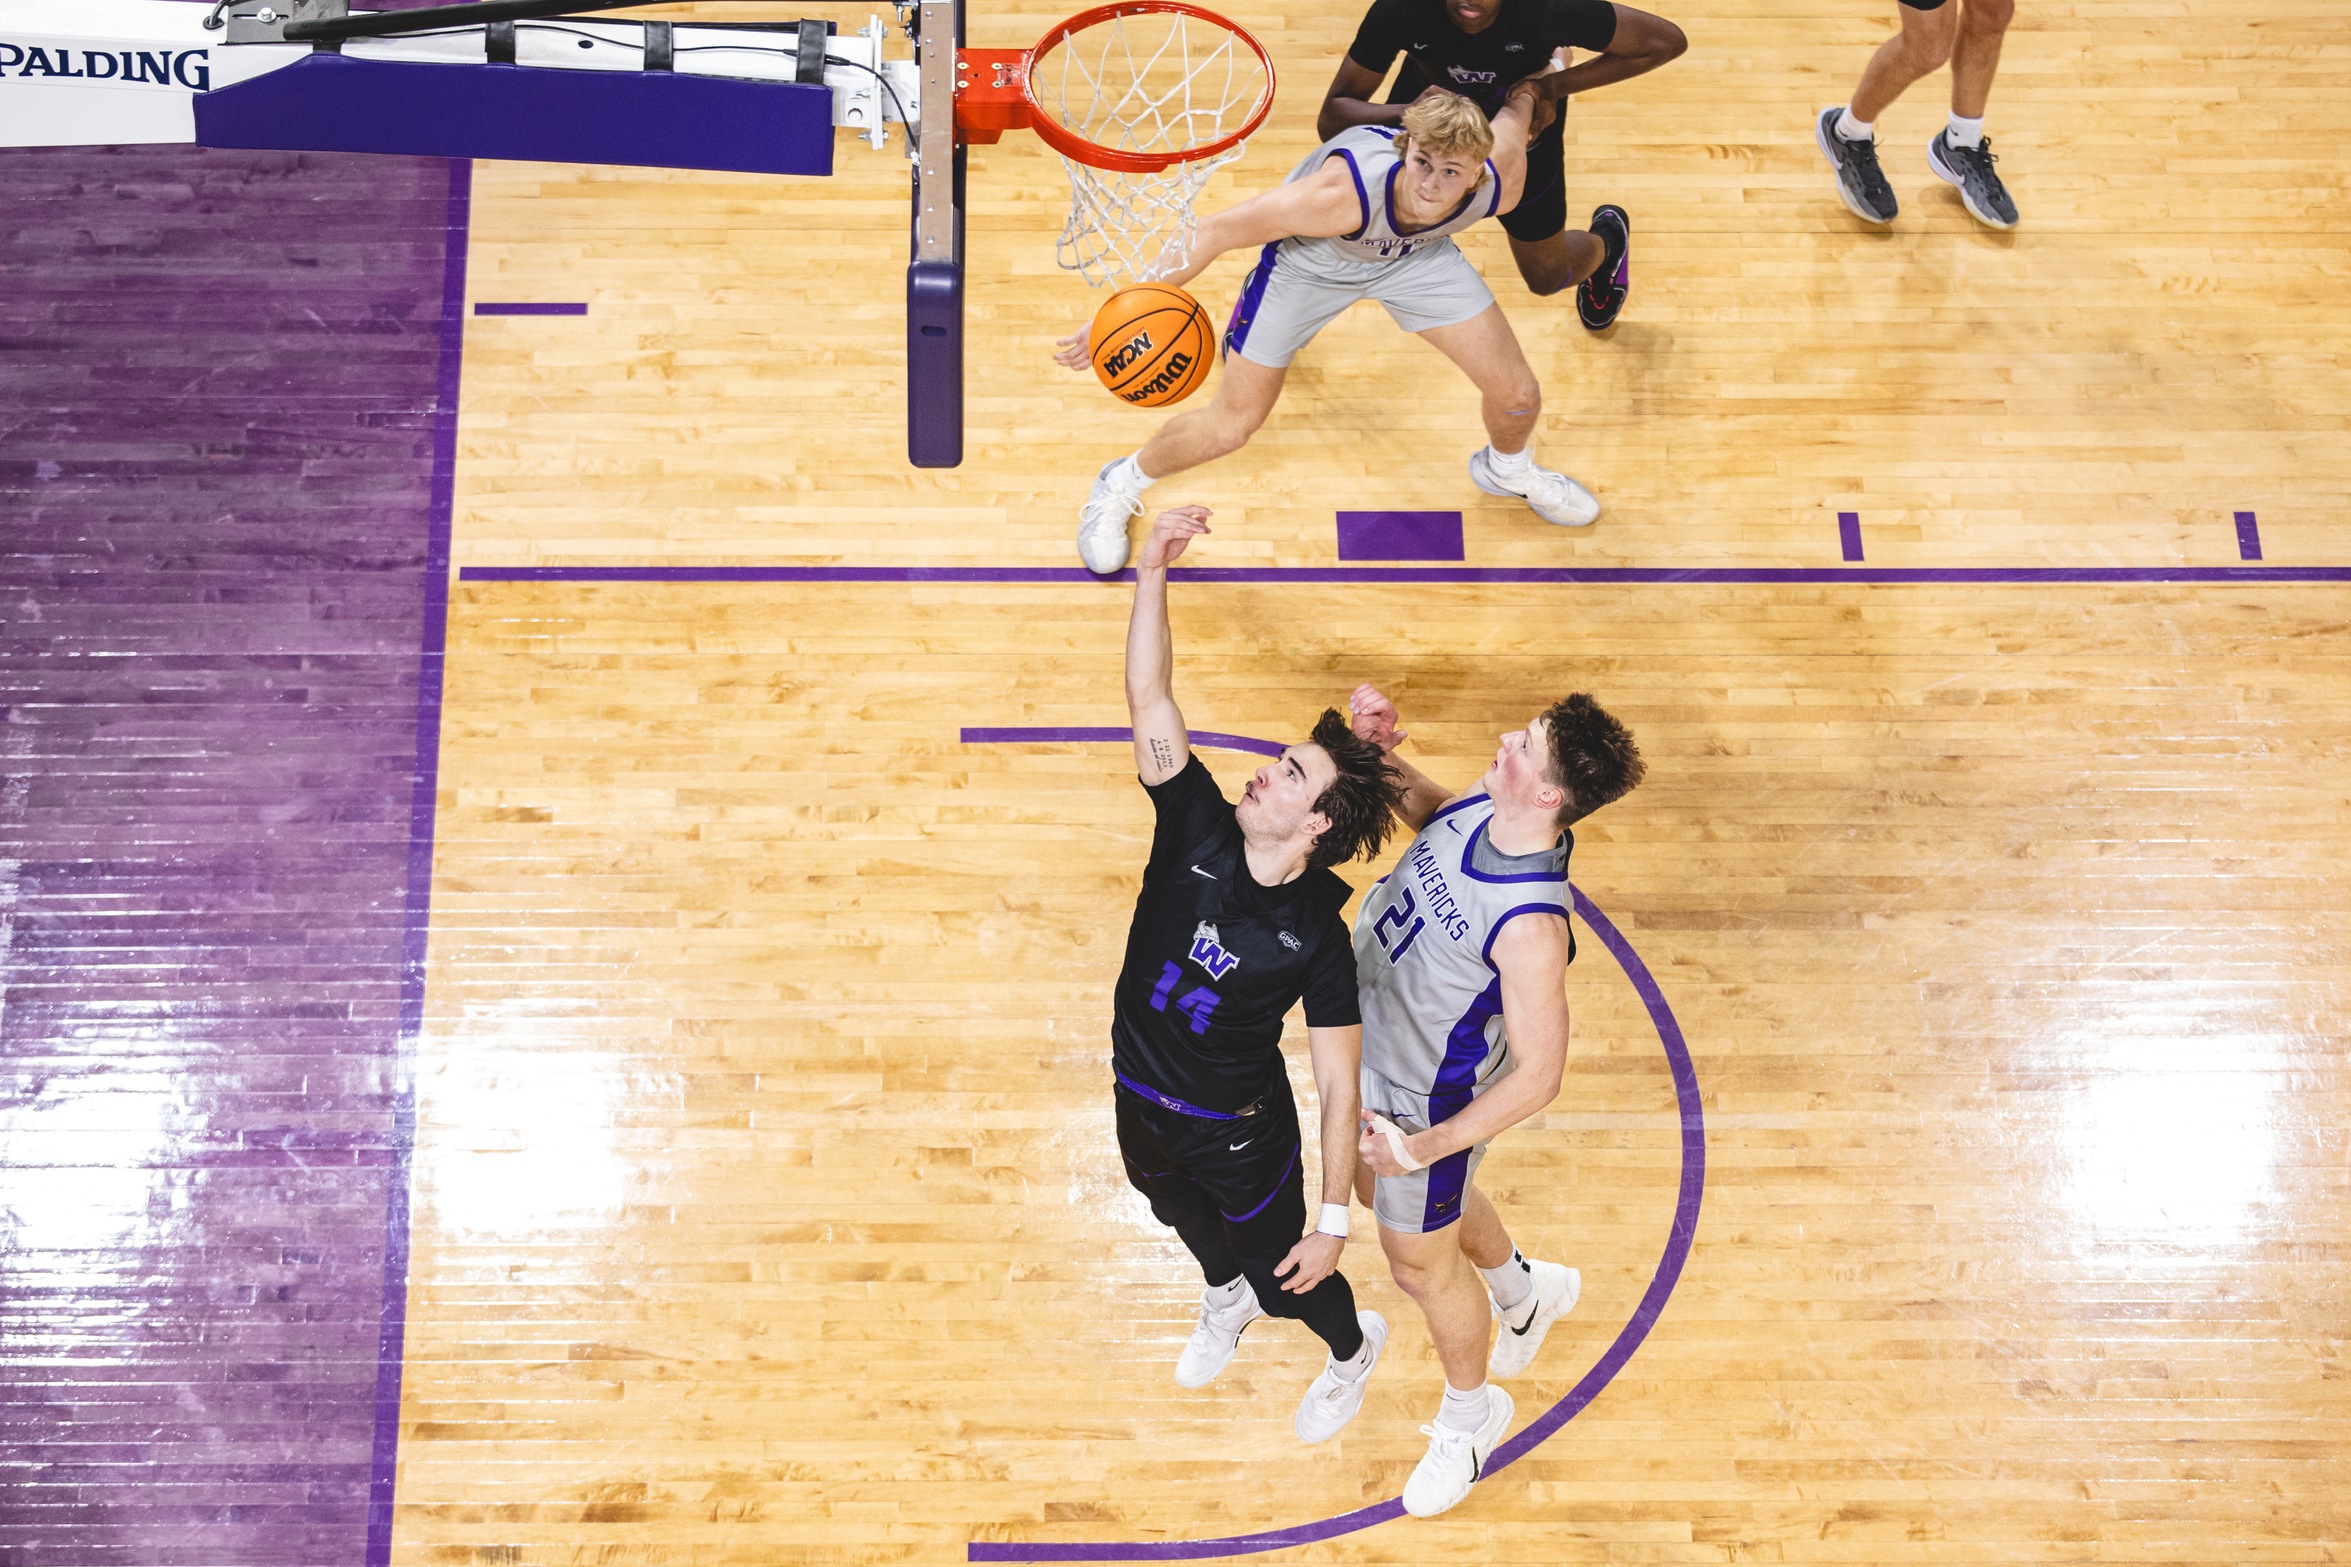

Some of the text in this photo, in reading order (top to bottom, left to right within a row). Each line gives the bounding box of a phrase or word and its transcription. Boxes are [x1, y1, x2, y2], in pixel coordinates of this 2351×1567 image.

[1103, 331, 1154, 378] NCAA
[1121, 352, 1193, 402] Wilson
[1409, 839, 1470, 942] MAVERICKS
[1279, 931, 1300, 951] GPAC
[1372, 885, 1427, 966] 21
[1188, 937, 1241, 982] W
[1150, 959, 1222, 1036] 14
